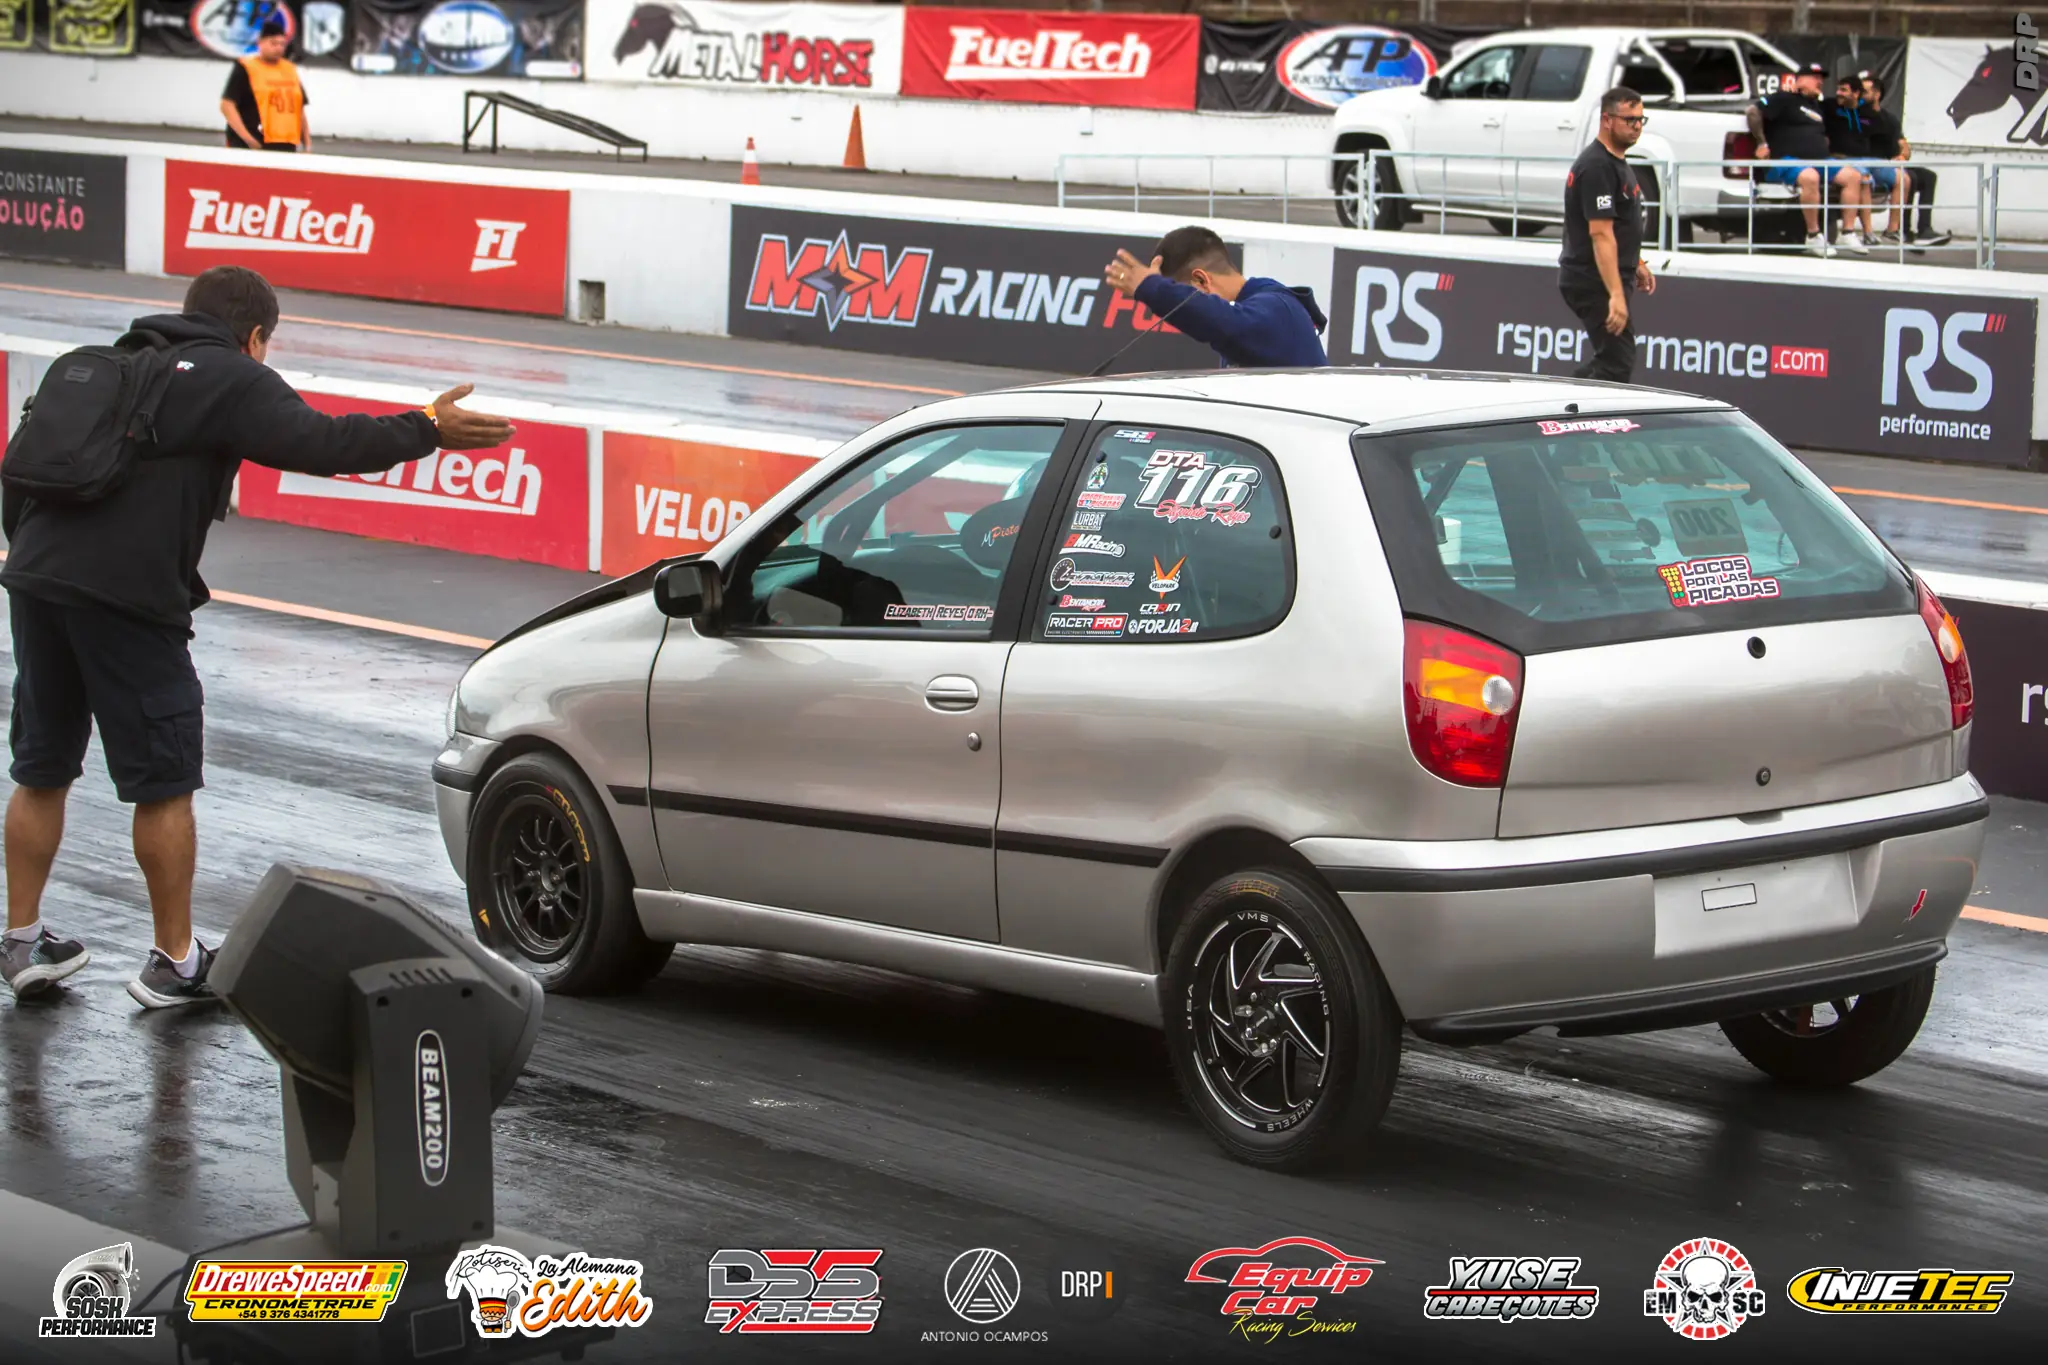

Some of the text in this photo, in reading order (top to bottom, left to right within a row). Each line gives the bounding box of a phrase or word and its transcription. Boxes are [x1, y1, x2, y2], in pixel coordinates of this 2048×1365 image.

[948, 26, 1151, 80] FuelTech
[186, 188, 374, 254] FuelTech
[930, 266, 1101, 326] RACING
[1351, 266, 1446, 361] RS
[1880, 308, 1998, 411] RS
[1879, 414, 1991, 441] performance
[1148, 451, 1205, 470] DTA
[1136, 463, 1260, 509] 116
[1681, 559, 1747, 576] LOCOS
[1685, 572, 1748, 588] POR LAS
[1688, 581, 1777, 603] PICADAS
[886, 605, 933, 618] ELIZABETH
[936, 606, 965, 619] REYES
[1049, 617, 1123, 627] RACER PRO
[1237, 912, 1269, 923] VMS
[1303, 951, 1329, 1016] RACING
[421, 1048, 443, 1169] BEAM200
[1266, 1098, 1313, 1132] WHEELS
